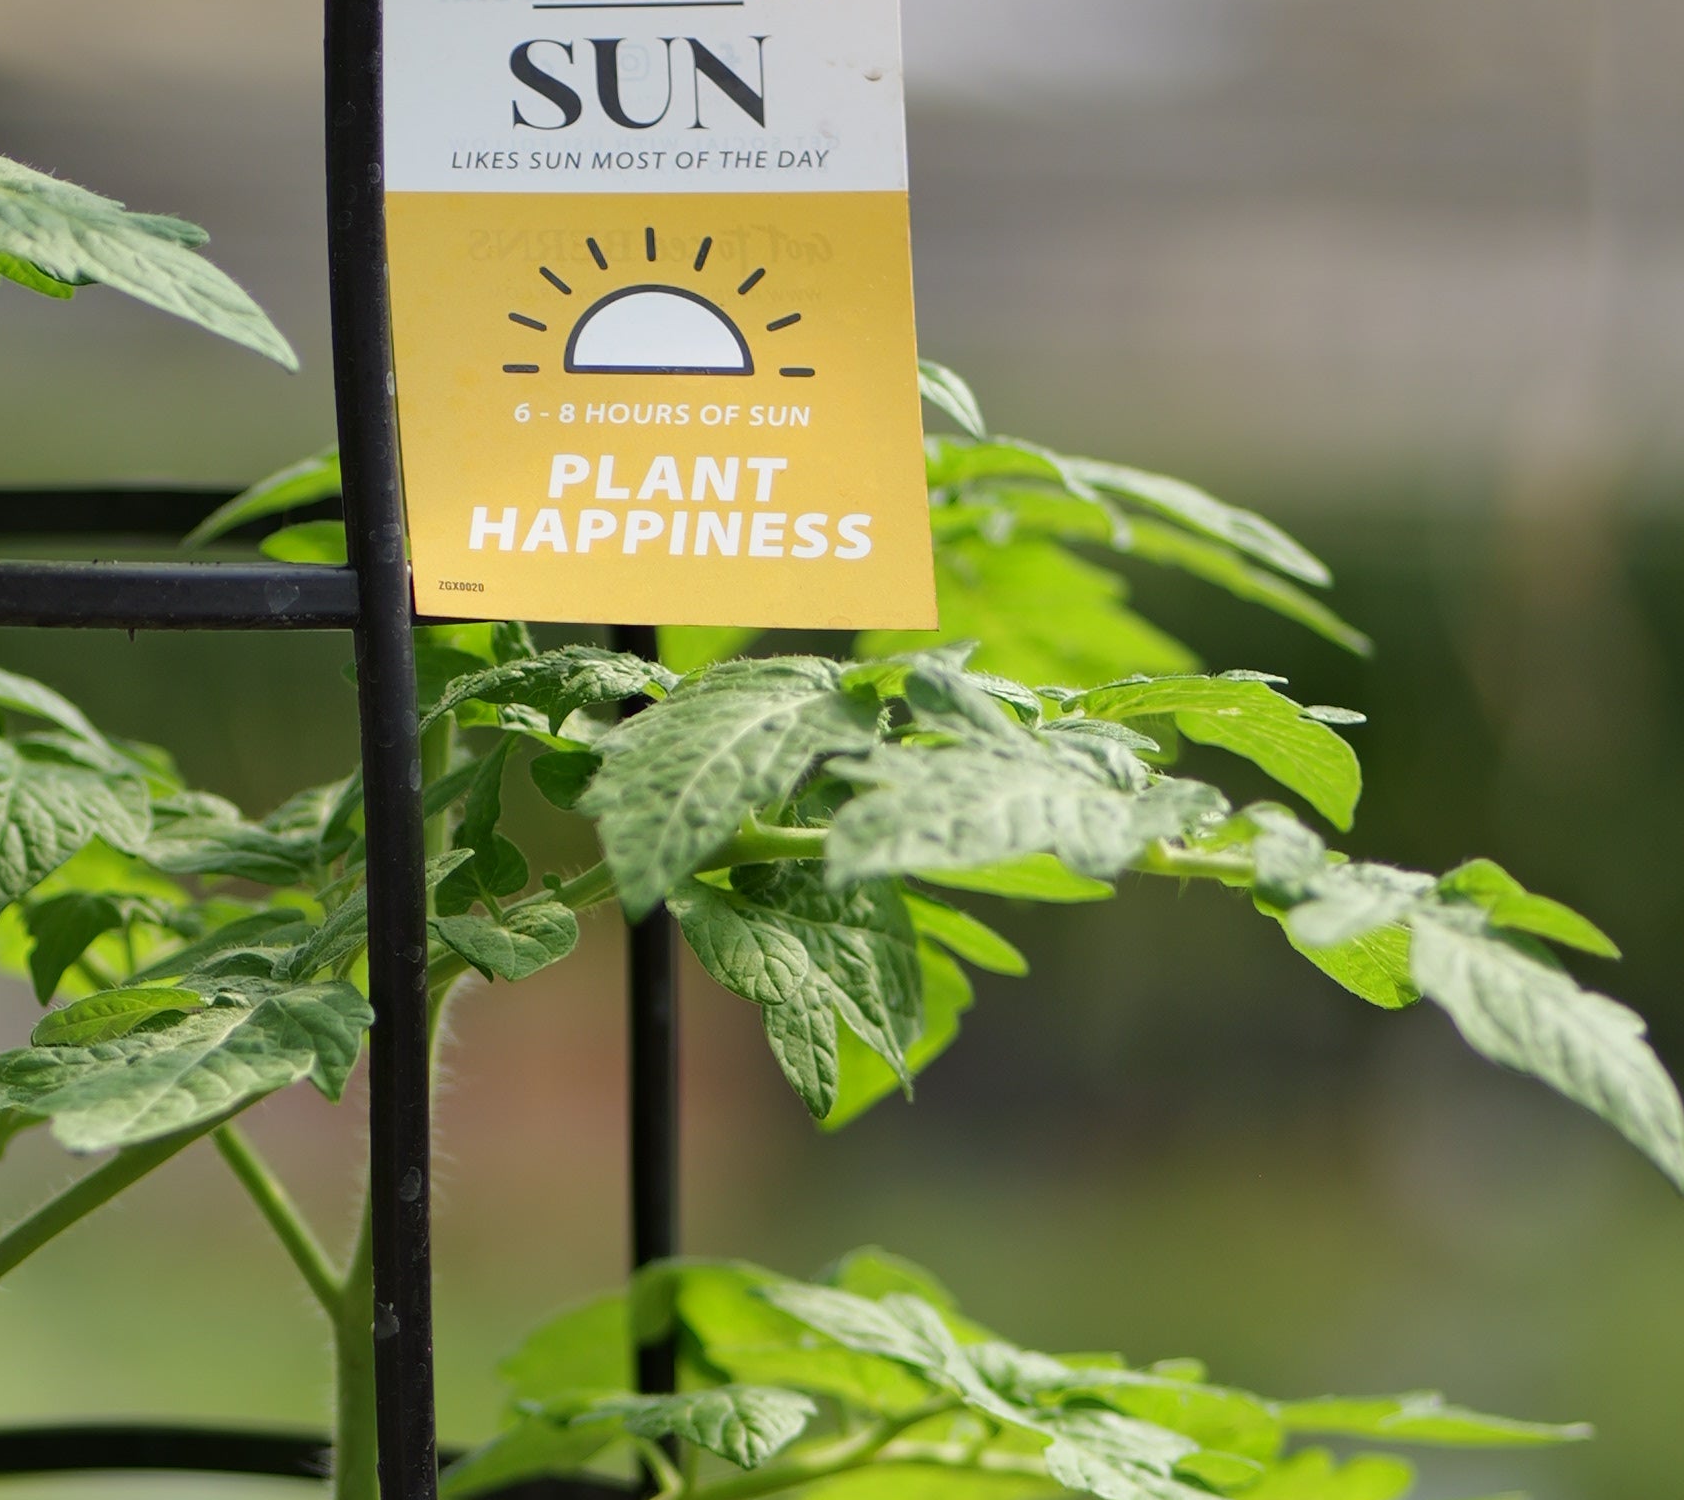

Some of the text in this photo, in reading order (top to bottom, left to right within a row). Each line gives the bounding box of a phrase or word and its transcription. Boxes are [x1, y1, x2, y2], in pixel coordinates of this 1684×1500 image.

[509, 35, 771, 131] SUN
[451, 150, 830, 170] LIKES SUN MOST OF THE DAY
[514, 402, 532, 423] 6
[559, 403, 576, 424] 8
[585, 403, 690, 426] HOURS
[700, 404, 740, 426] OF
[749, 405, 811, 427] SUN
[548, 454, 788, 502] PLANT
[468, 507, 873, 560] HAPPINESS
[438, 580, 485, 593] ZGX0020
